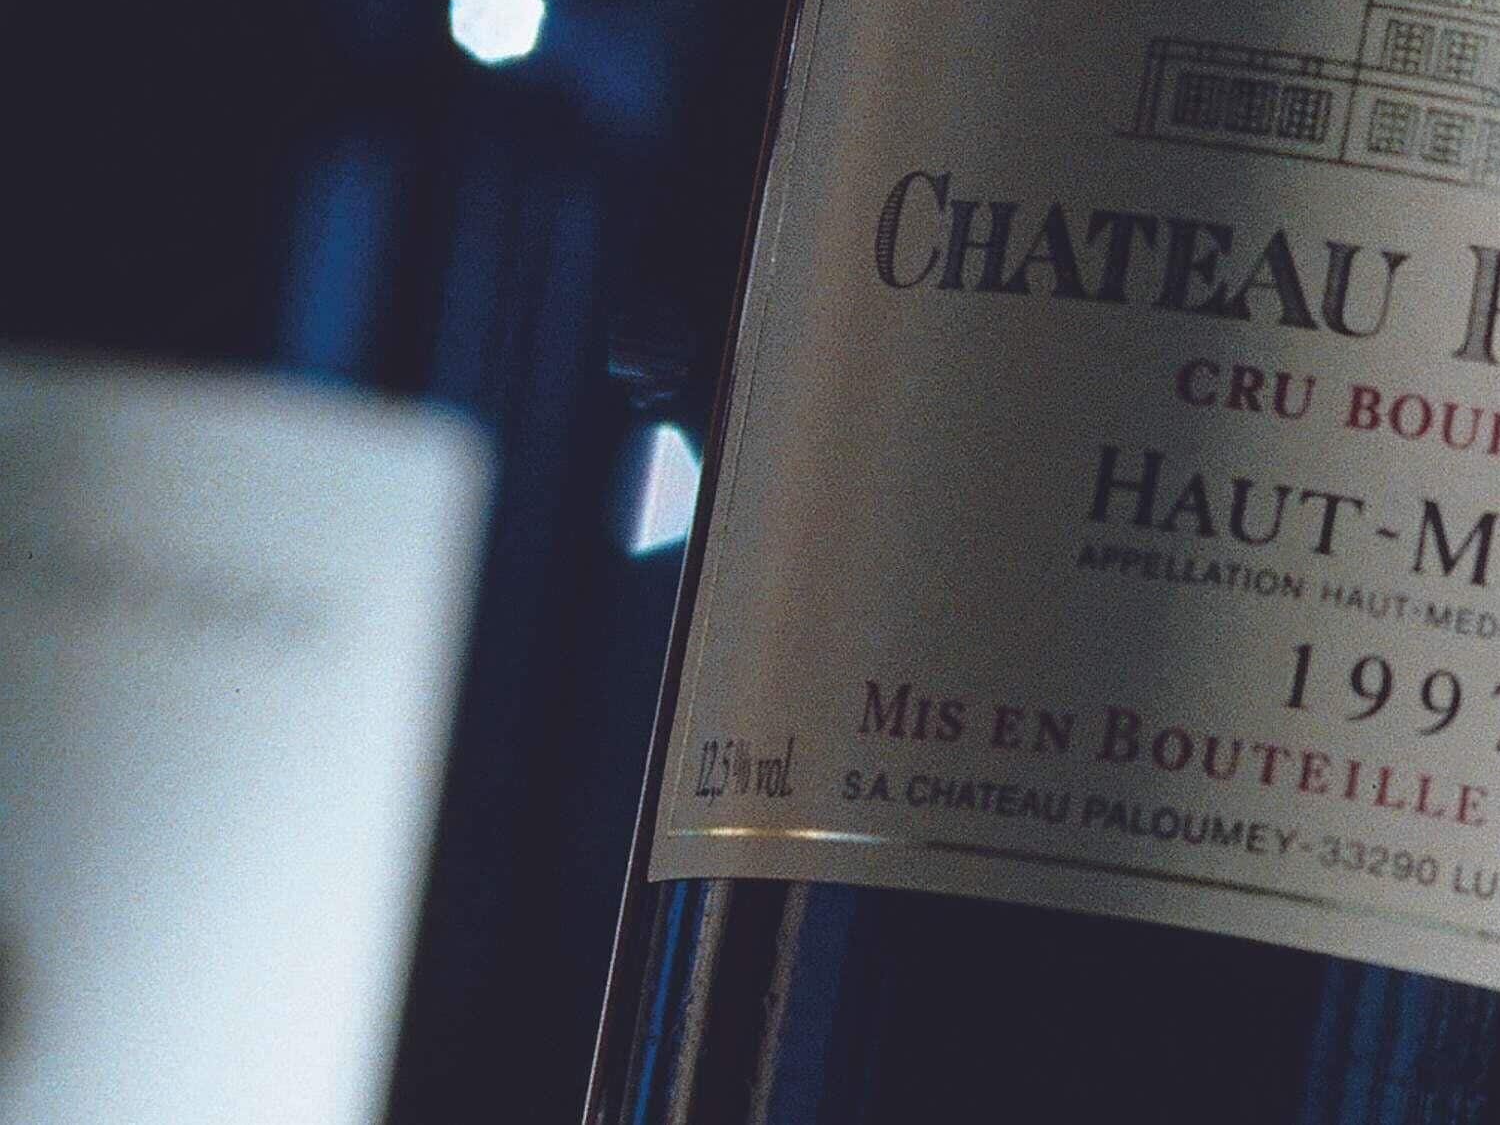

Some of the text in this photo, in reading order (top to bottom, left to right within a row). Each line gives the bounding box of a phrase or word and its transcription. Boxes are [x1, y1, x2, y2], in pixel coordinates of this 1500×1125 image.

[874, 170, 1409, 338] CHATEAU
[1176, 358, 1317, 420] CRU
[1076, 543, 1304, 599] APPELLATION
[857, 679, 966, 743] MIS
[992, 705, 1074, 755] EN
[1098, 706, 1488, 827] BOUTEILLE
[906, 774, 1072, 825] CHATEAU
